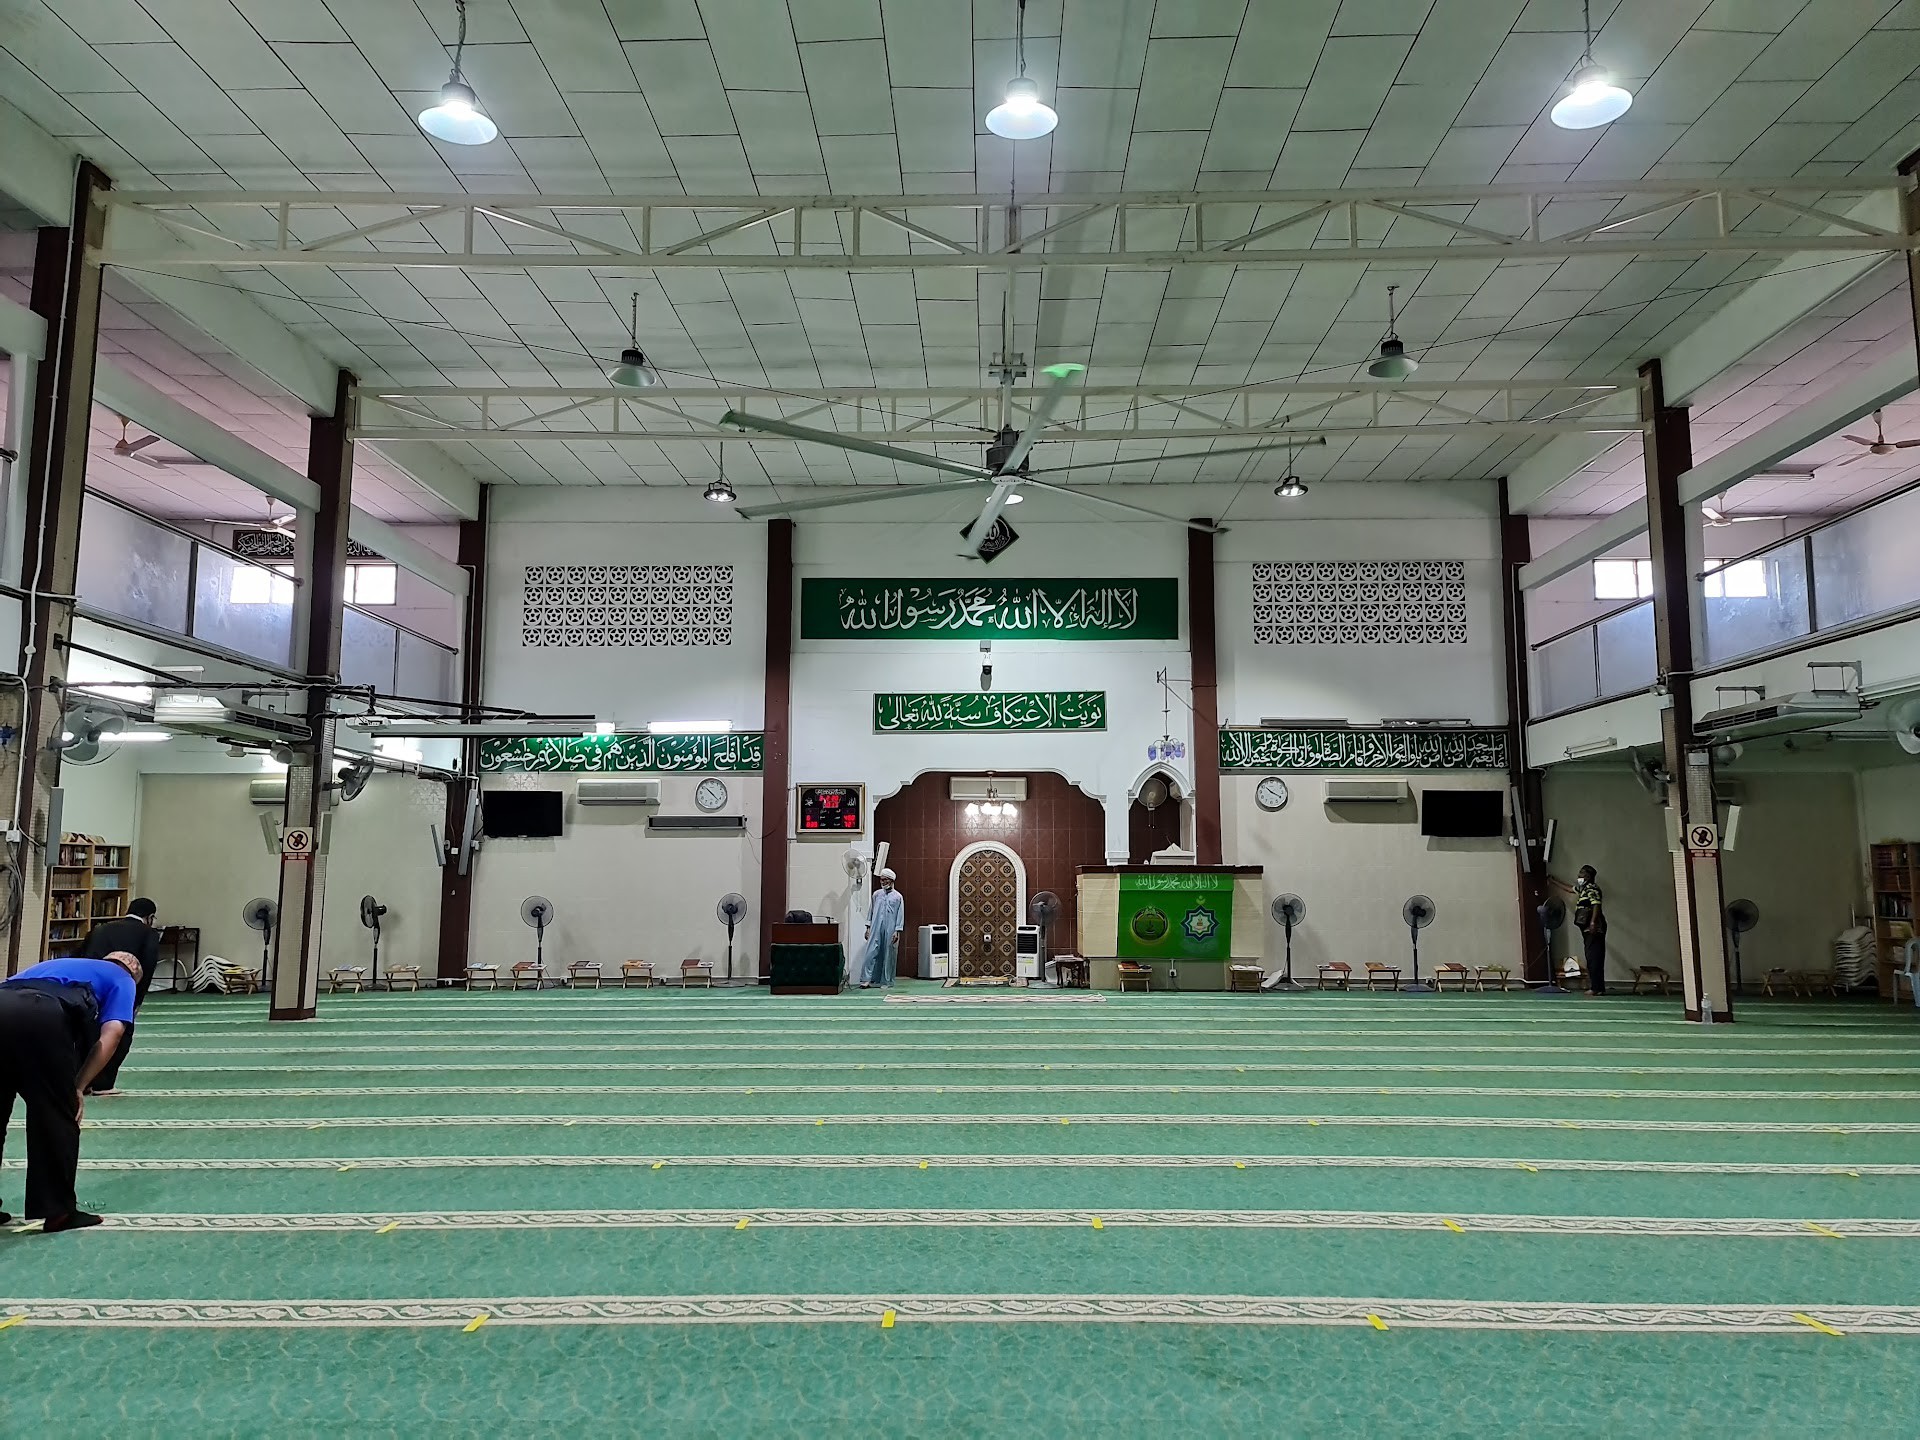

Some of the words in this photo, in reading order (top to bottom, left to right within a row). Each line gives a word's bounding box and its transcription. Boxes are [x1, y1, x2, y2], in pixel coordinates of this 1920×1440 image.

[839, 588, 891, 630] الله
[880, 588, 956, 630] رسول
[950, 587, 996, 629] محمد
[994, 588, 1038, 629] الله
[1113, 588, 1138, 629] لا
[878, 696, 921, 729] تعالى
[916, 696, 943, 729] لله
[943, 695, 981, 722] سنة
[1060, 694, 1103, 728] نويت
[604, 738, 622, 770] هم
[616, 737, 655, 770] الذين
[657, 736, 710, 770] المؤمنون
[742, 736, 761, 768] قد
